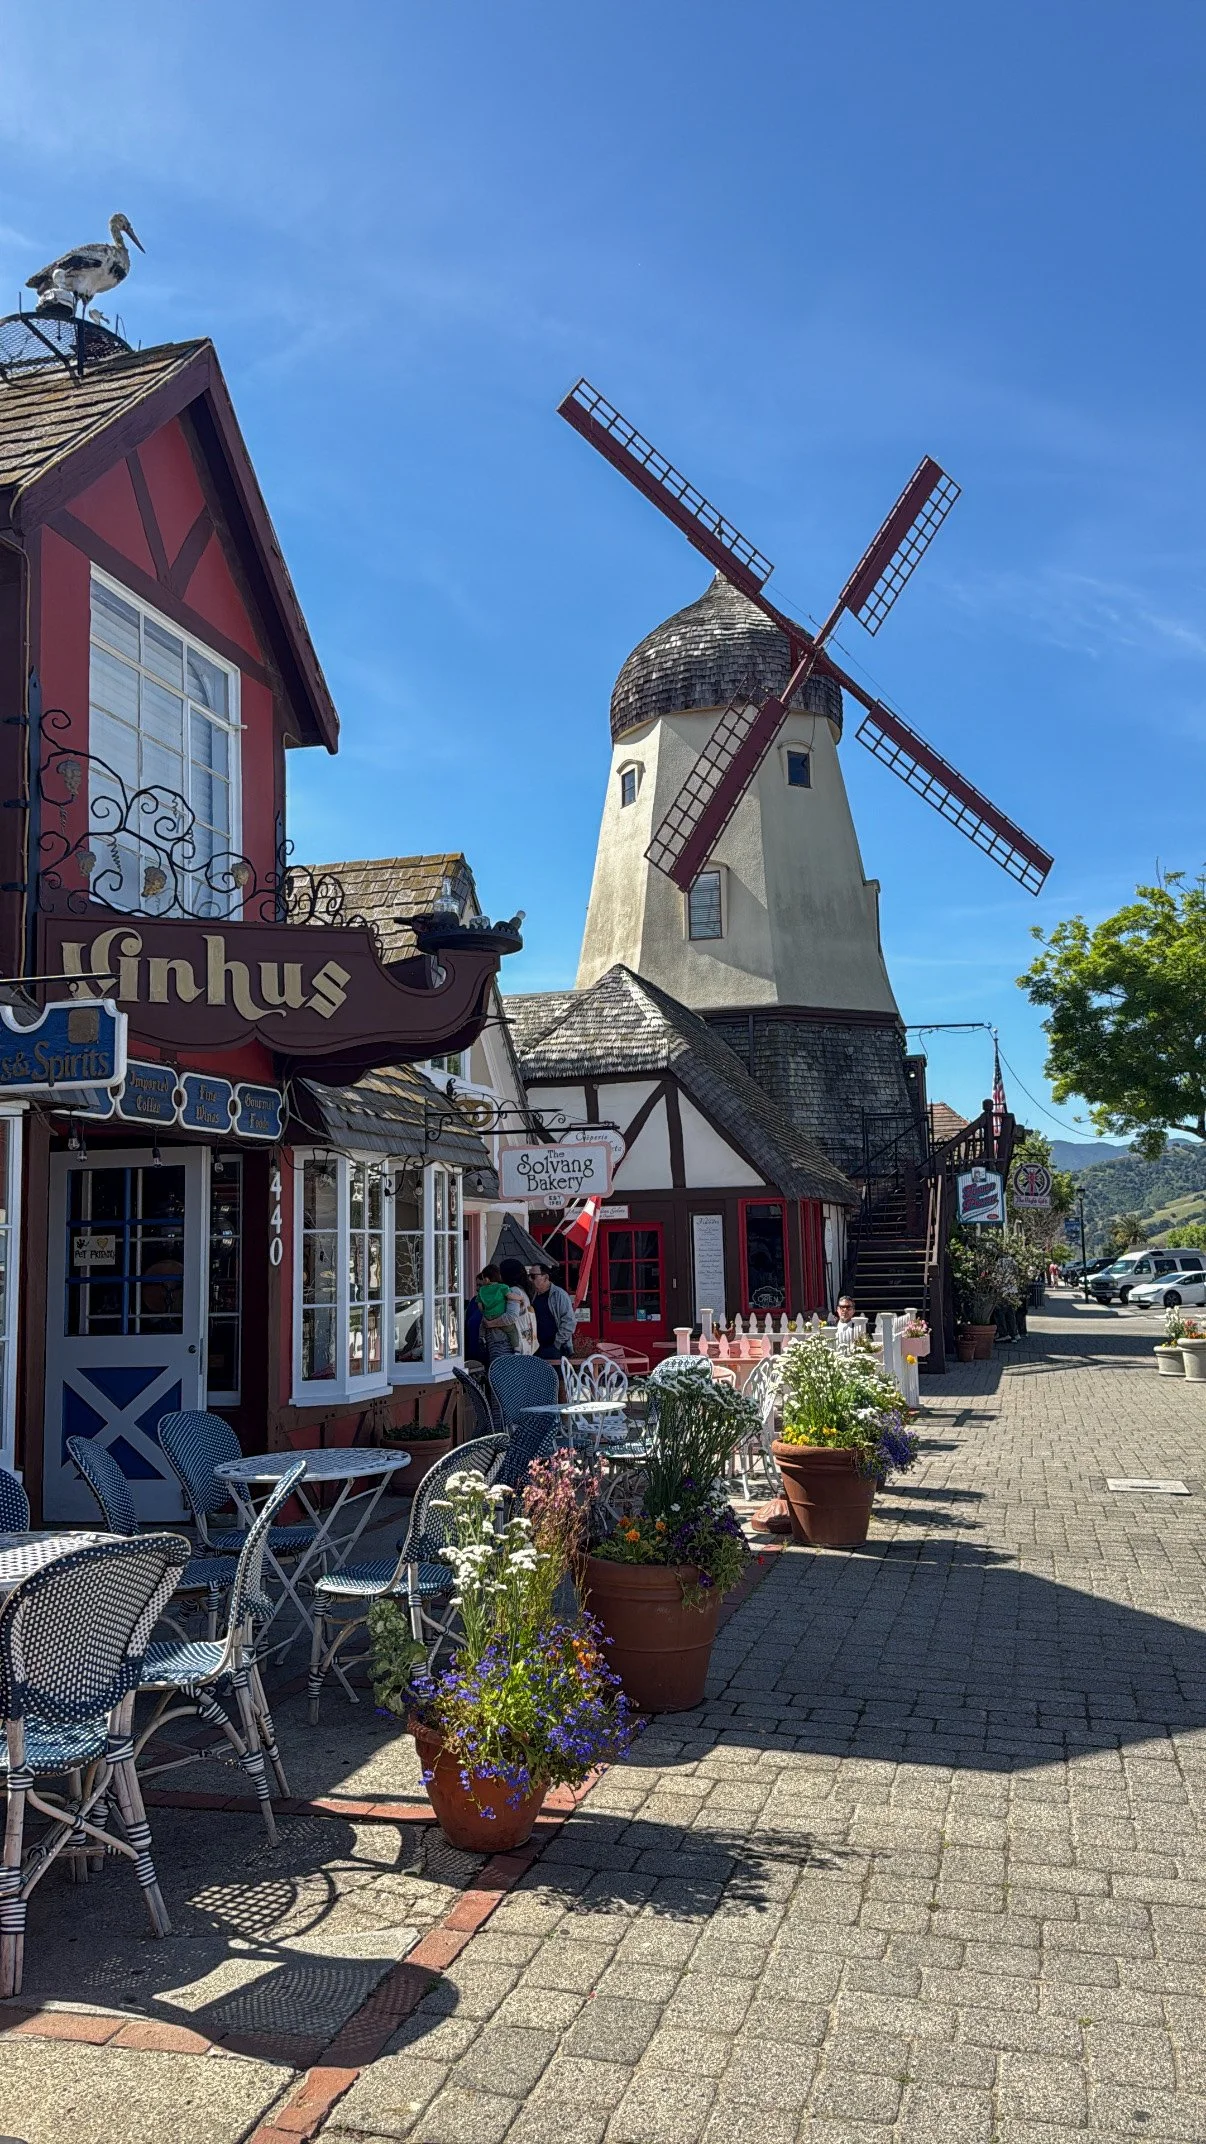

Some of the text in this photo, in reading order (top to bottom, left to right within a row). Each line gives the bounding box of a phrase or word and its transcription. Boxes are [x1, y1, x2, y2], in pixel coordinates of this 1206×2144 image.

[31, 1041, 110, 1087] Spirits
[199, 1084, 217, 1103] Fine
[136, 1094, 160, 1114] Coffee
[196, 1106, 220, 1124] Wines
[547, 1149, 565, 1159] The
[516, 1153, 594, 1178] Solvang
[526, 1174, 584, 1193] Bakery
[269, 1170, 283, 1266] 440
[74, 1250, 86, 1259] PET
[757, 1294, 779, 1303] OPEN
